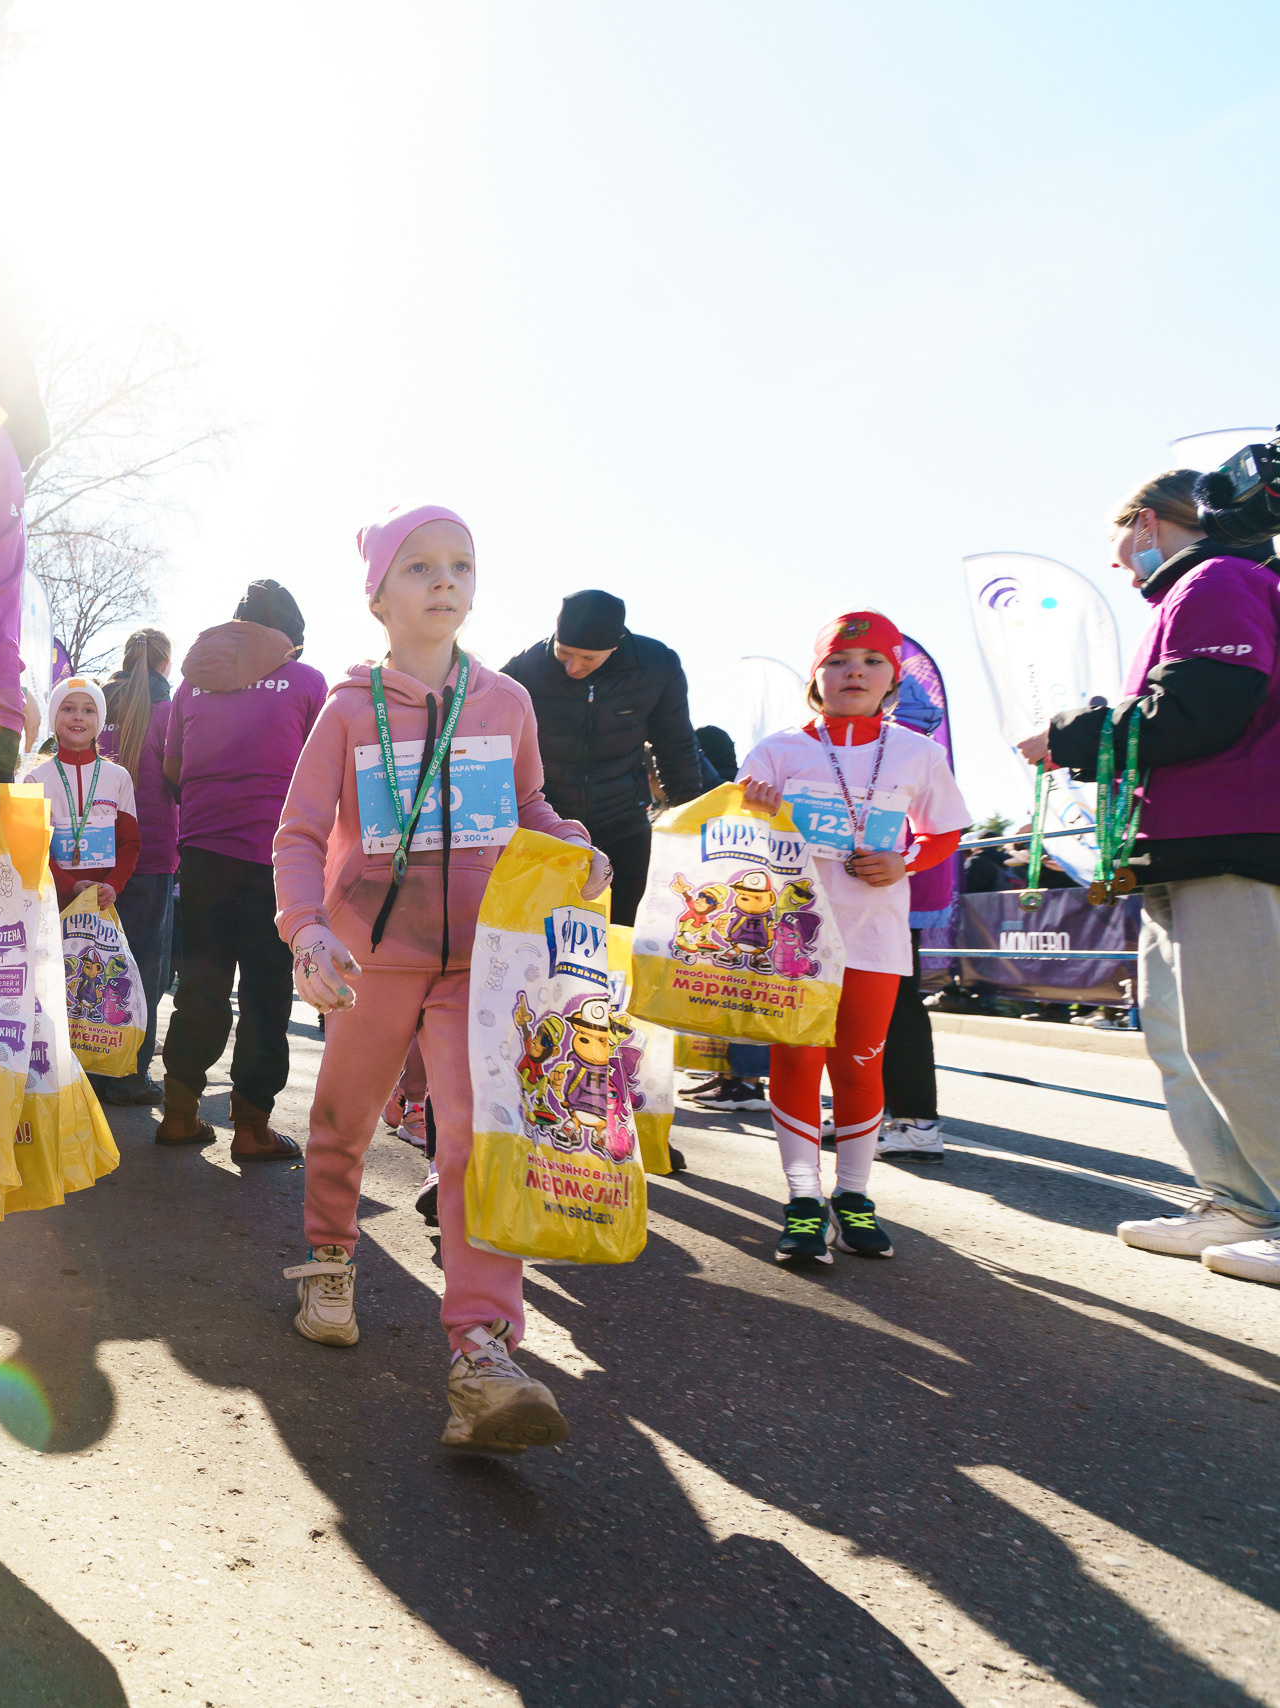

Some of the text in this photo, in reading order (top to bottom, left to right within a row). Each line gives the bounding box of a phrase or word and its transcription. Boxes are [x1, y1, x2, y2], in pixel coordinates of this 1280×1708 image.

[438, 697, 463, 753] МЕНЯЮЩИЙ
[457, 666, 468, 697] ЖИЗНЬ
[380, 725, 398, 787] МЕНЯЮЩИЙ
[808, 812, 853, 837] 123
[60, 838, 89, 853] 129
[675, 968, 798, 993] необычайно вкусный
[672, 977, 806, 1010] мармелад!
[688, 995, 784, 1018] www.sladskaz.ru
[70, 1030, 123, 1048] мелад!
[88, 1027, 119, 1035] вкусный
[71, 1041, 110, 1054] sladskaz.ru
